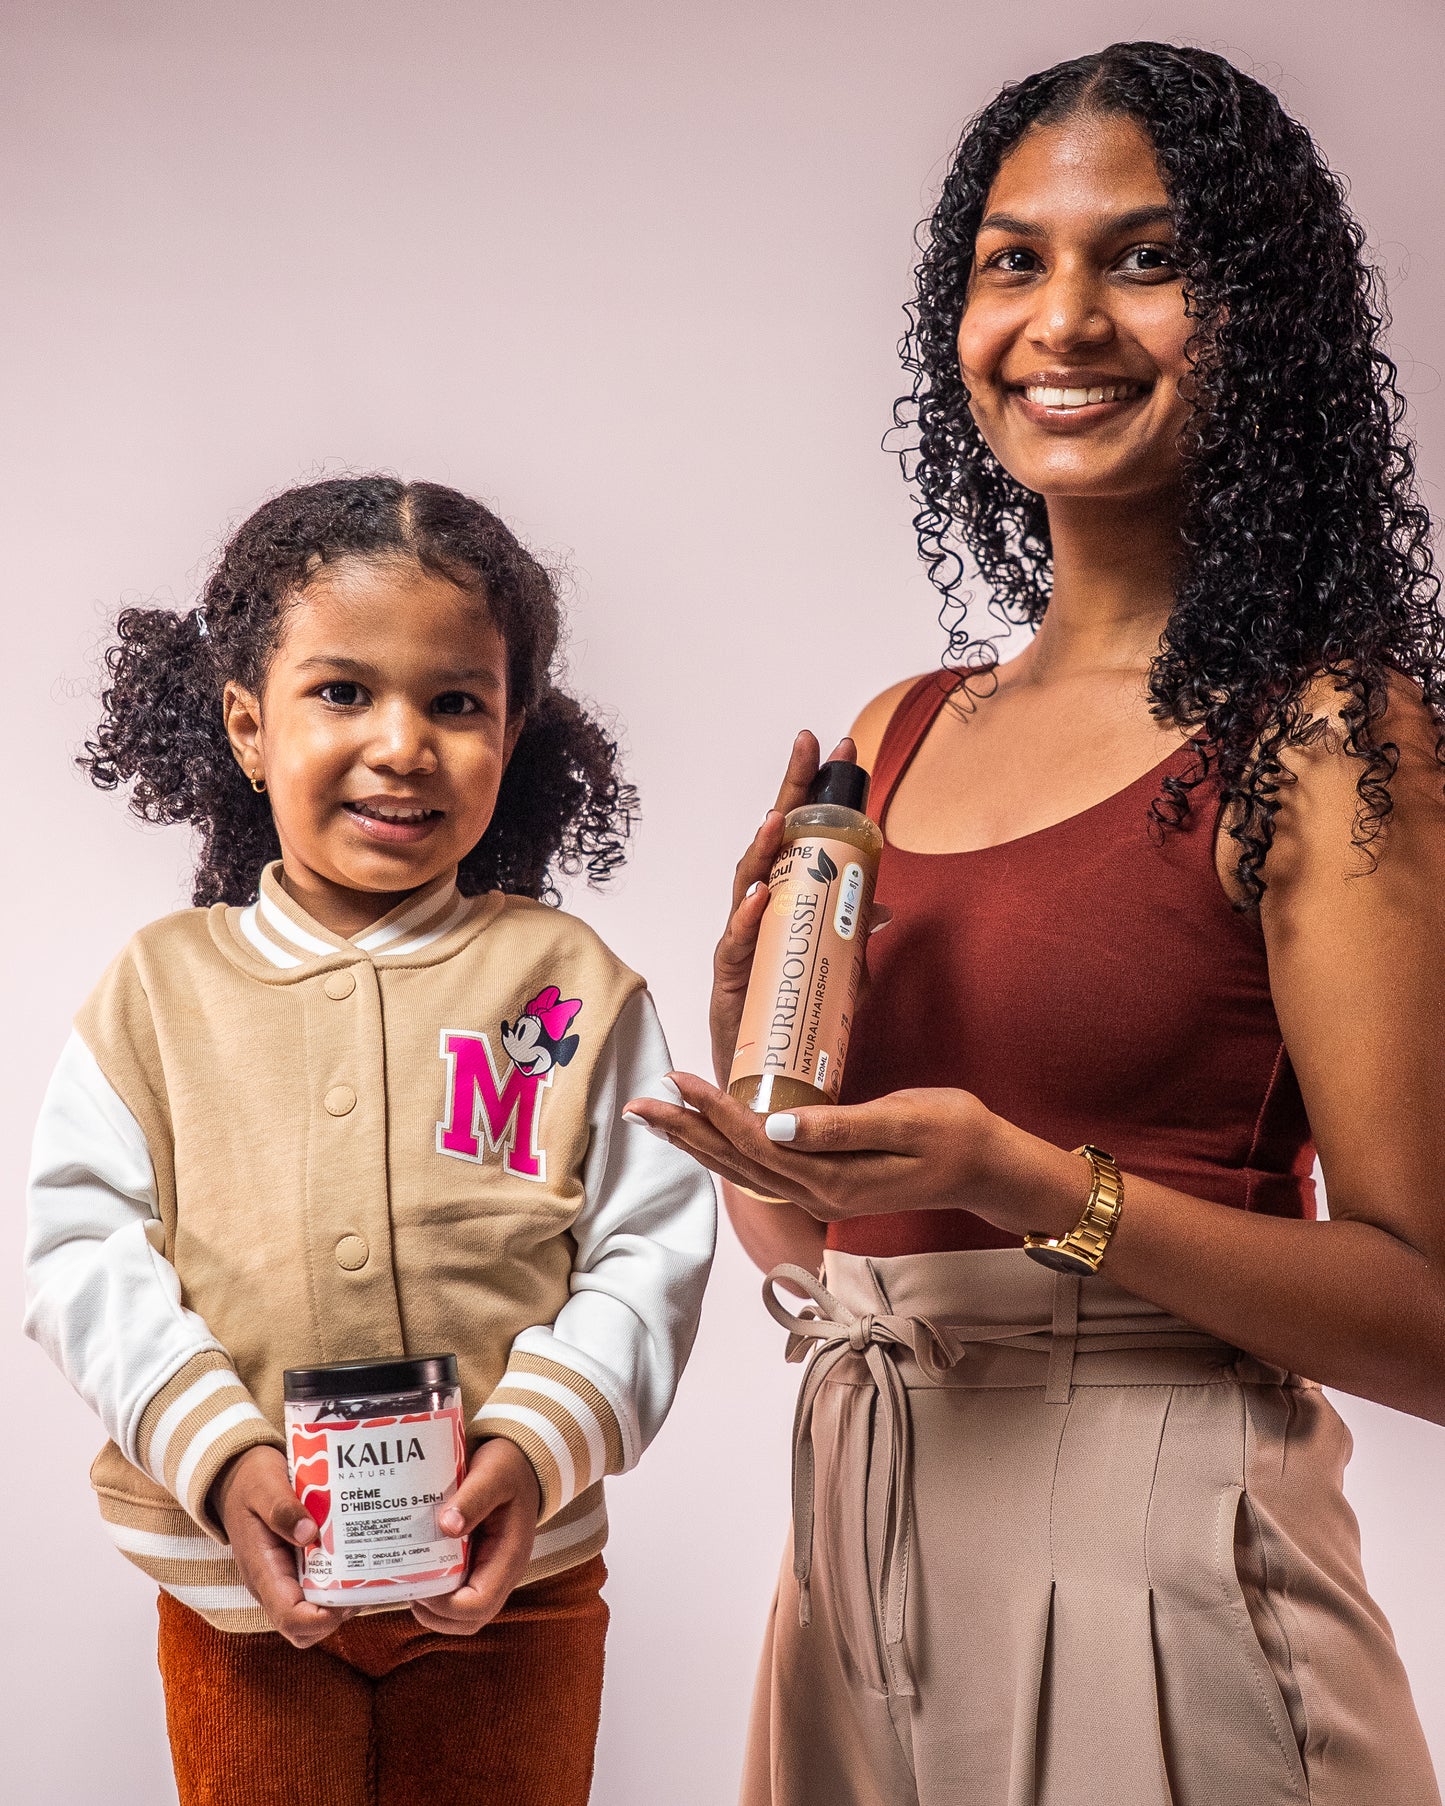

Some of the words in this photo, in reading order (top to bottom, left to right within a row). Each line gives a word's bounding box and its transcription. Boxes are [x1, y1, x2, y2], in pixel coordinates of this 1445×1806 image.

[764, 893, 819, 1069] PUREPOUSSE
[801, 957, 830, 1074] NATURALHAIRSHOP
[817, 1055, 828, 1082] 250ML
[436, 1028, 557, 1183] M
[336, 1437, 426, 1469] KALIA
[338, 1467, 396, 1480] NATURE
[340, 1487, 381, 1500] CRÈME
[341, 1497, 408, 1512] D'HIBISCUS
[308, 1567, 333, 1575] FRANCE
